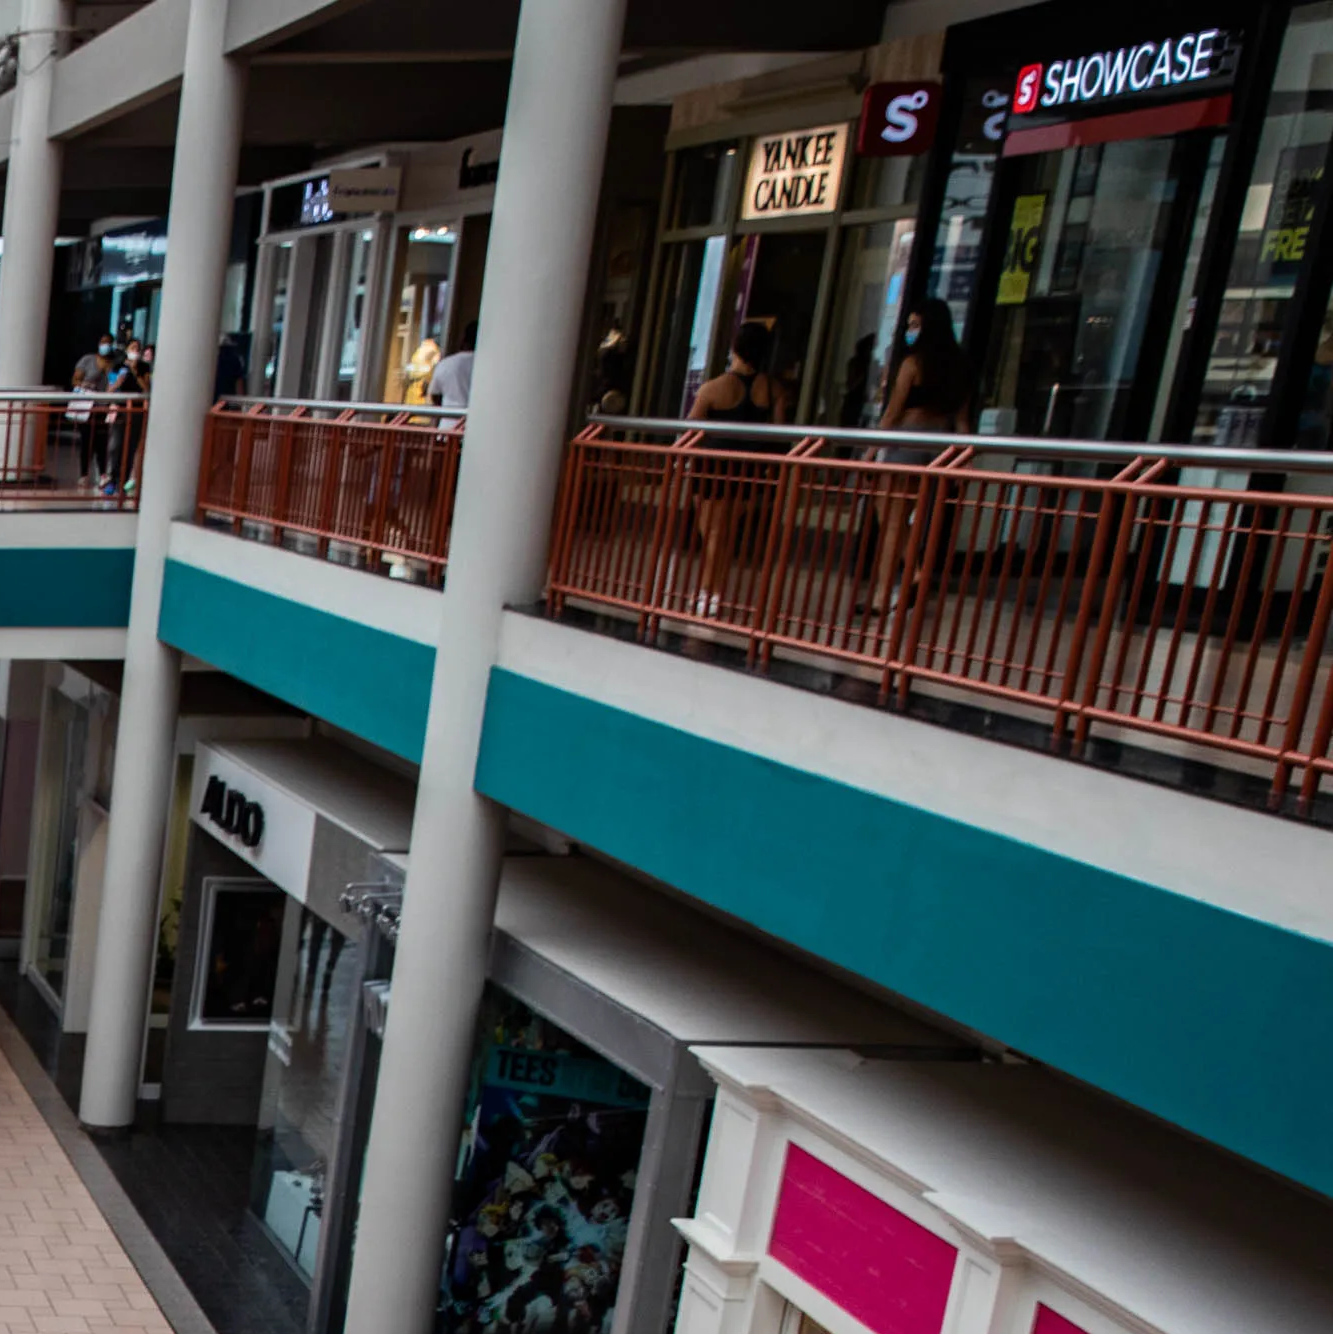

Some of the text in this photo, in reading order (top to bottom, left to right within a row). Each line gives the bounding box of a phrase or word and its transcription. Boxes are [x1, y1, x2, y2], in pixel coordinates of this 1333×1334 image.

[1040, 28, 1220, 107] SHOWCASE
[762, 131, 837, 173] YANKEE
[754, 172, 829, 212] CANDLE
[200, 775, 265, 848] ALDO
[498, 1050, 559, 1086] TEES
